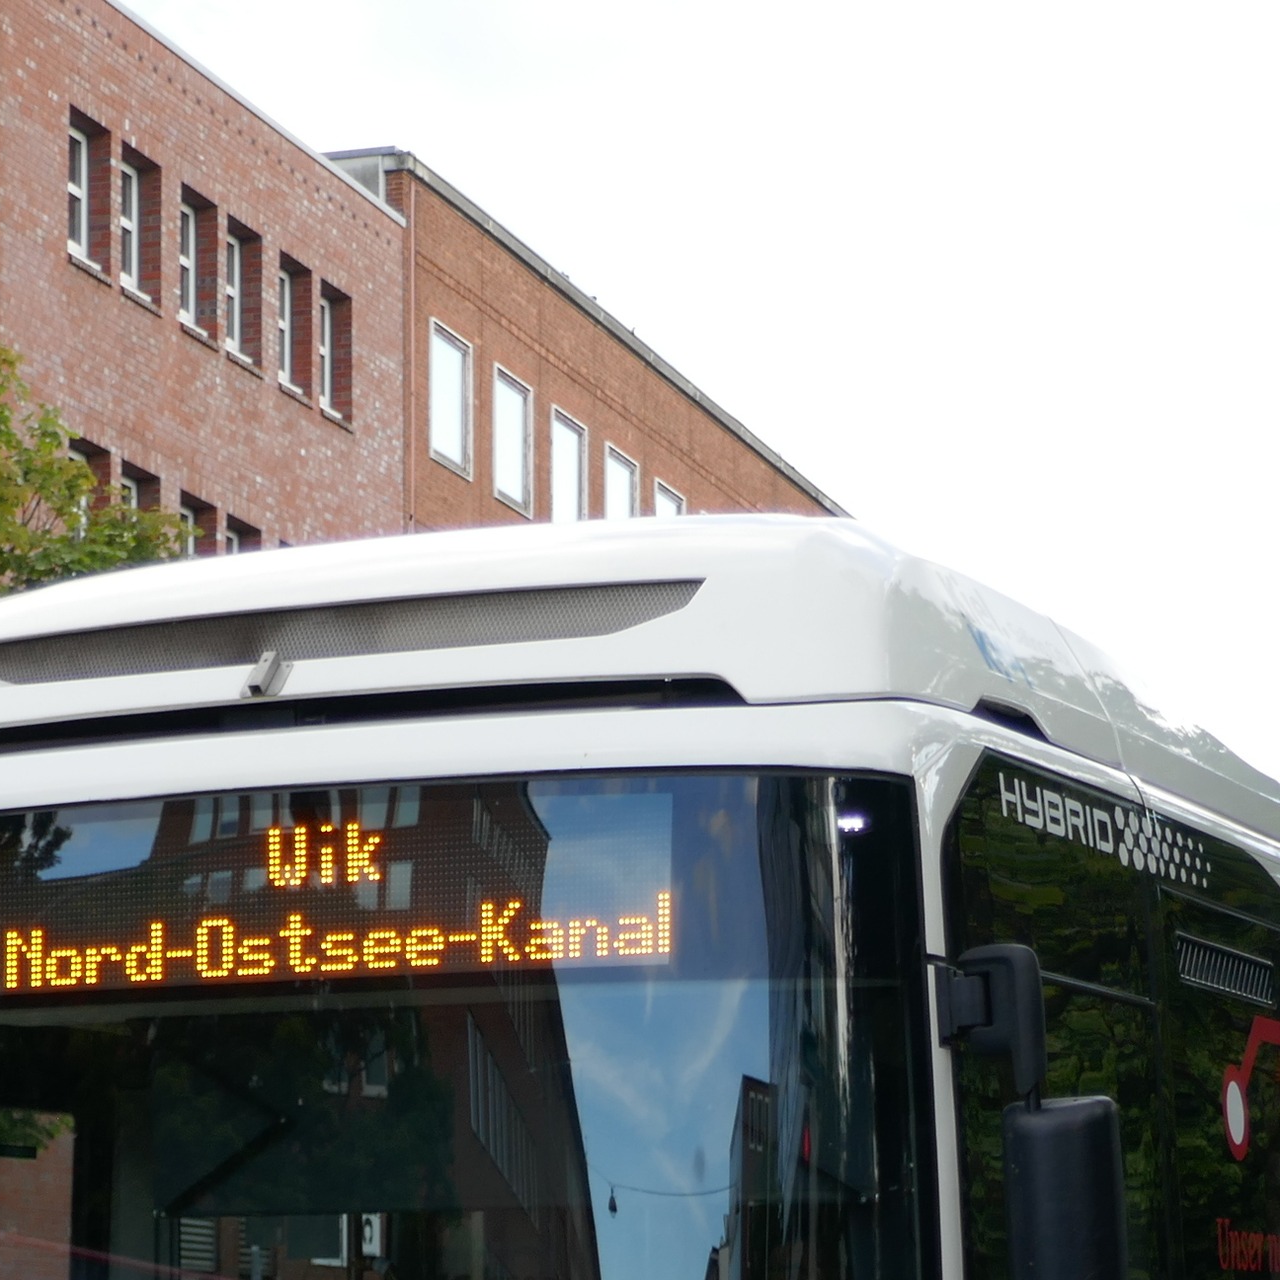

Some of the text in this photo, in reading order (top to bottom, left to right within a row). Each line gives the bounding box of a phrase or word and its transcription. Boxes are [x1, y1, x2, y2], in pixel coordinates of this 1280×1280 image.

[998, 771, 1114, 855] HYBRID
[265, 821, 384, 887] Wik
[4, 891, 671, 990] Nord-Ostsee-Kanal
[1215, 1218, 1263, 1272] Unser
